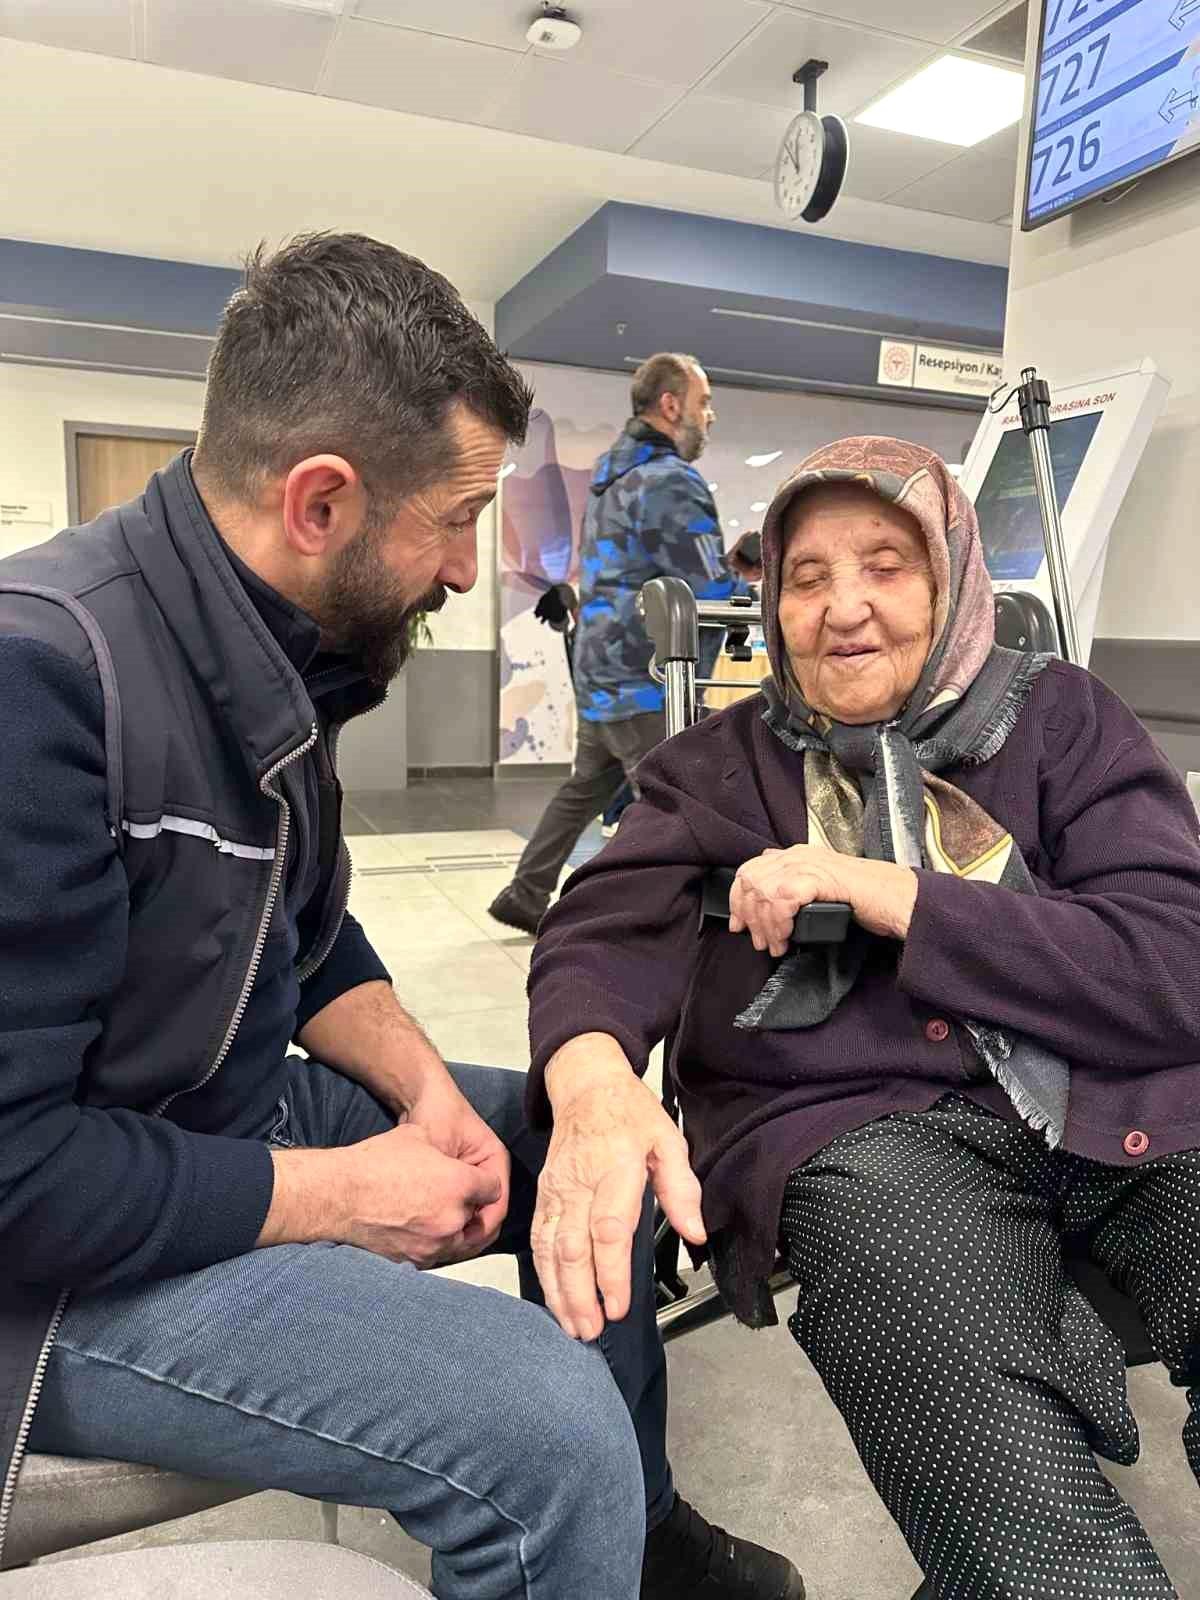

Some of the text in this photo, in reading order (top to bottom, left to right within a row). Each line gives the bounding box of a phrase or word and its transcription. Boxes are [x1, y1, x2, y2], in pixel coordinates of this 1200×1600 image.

[1041, 33, 1111, 117] 727
[1033, 120, 1101, 196] 726
[919, 354, 978, 374] Resepsiyon
[1092, 392, 1117, 406] SON
